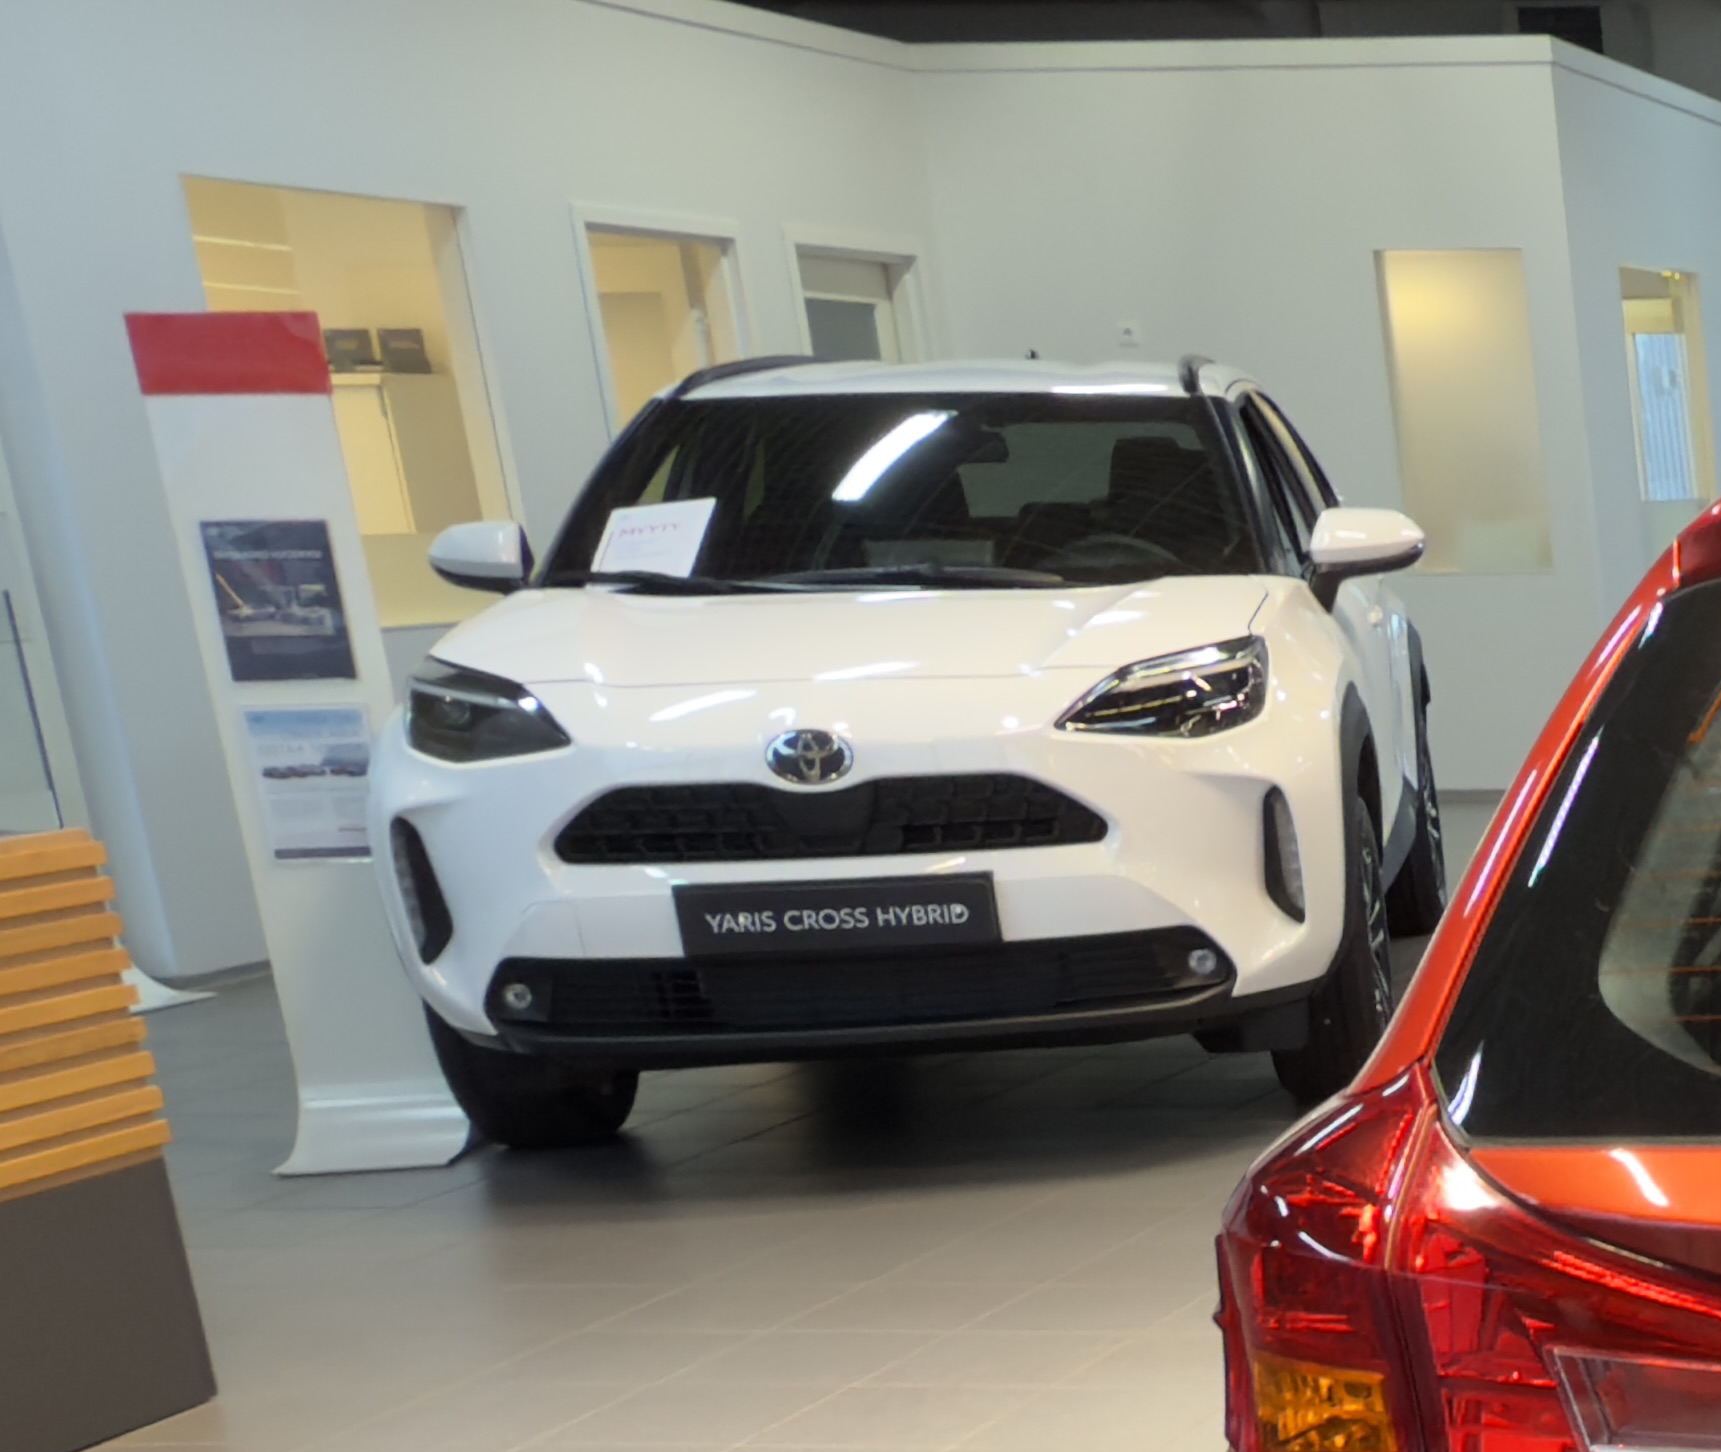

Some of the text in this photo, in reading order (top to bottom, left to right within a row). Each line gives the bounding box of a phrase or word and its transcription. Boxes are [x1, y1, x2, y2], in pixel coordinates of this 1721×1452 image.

[704, 903, 970, 934] YARIS CROSS HYBRID
